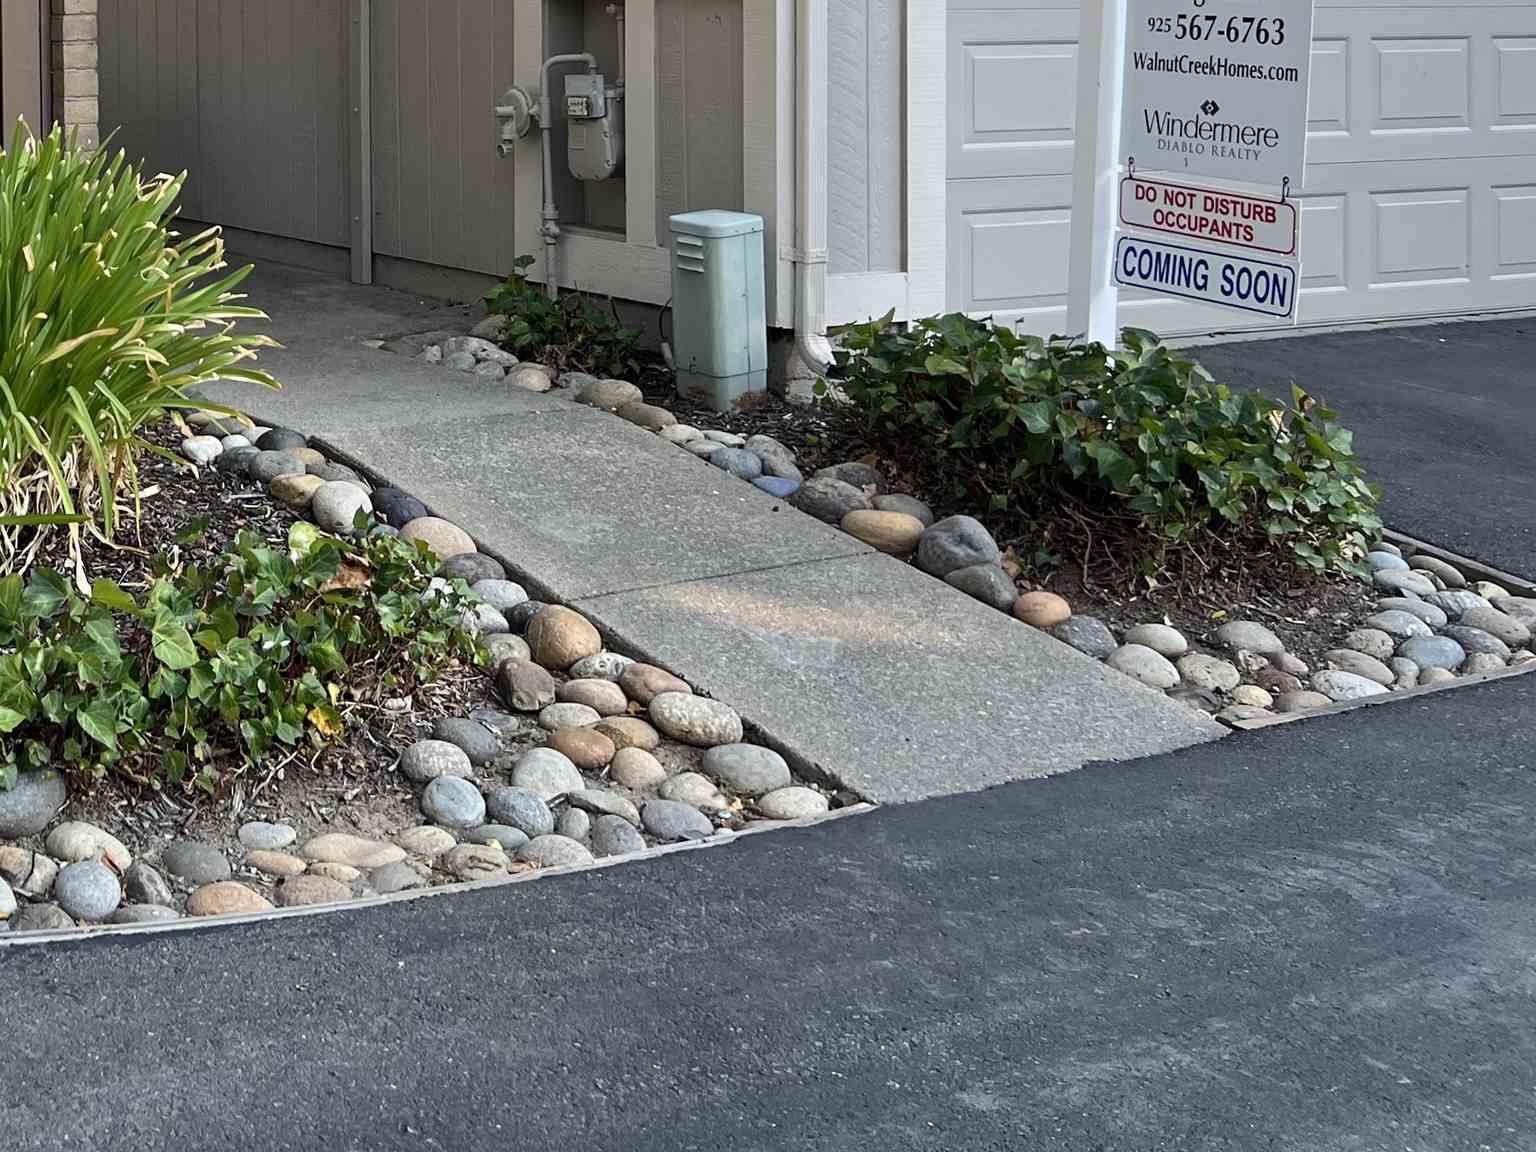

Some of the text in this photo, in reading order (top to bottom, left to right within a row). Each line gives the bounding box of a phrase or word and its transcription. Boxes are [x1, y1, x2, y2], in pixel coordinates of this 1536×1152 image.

[1147, 13, 1285, 46] 925 567-6763
[1133, 51, 1299, 83] WalnutCreekHomes.com
[1143, 108, 1280, 148] Windermere
[1157, 138, 1262, 161] DIABLO REALTY
[1134, 184, 1277, 224] DO NOT DISTURB
[1153, 209, 1254, 242] OCCUPANTS
[1123, 245, 1287, 307] COMING SOON
